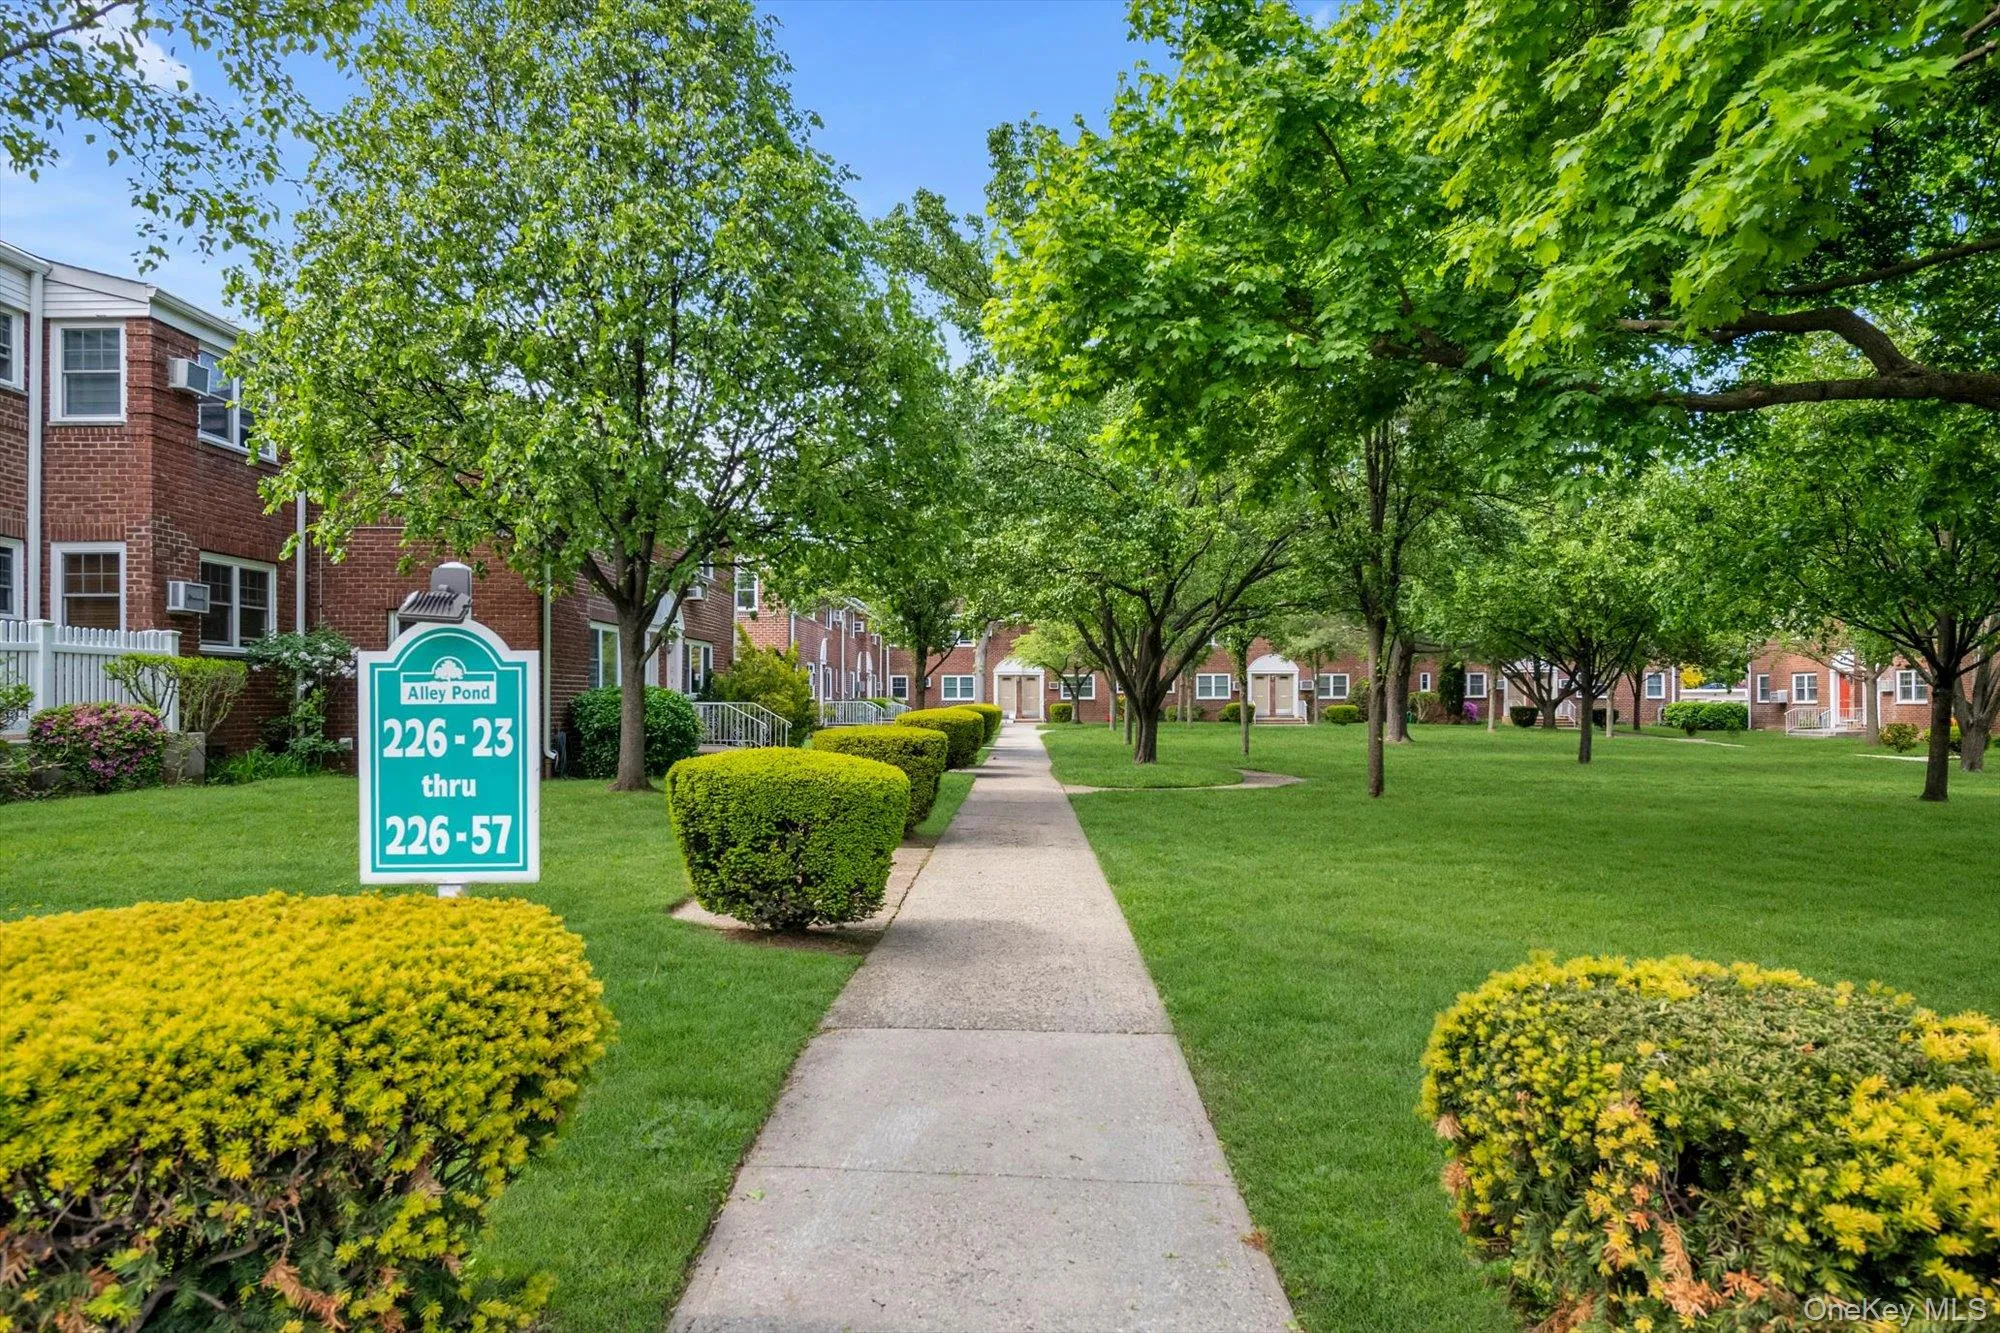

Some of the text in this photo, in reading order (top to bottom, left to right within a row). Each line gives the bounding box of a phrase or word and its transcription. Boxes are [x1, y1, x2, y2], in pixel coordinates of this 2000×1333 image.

[408, 685, 490, 703] Alley Pond
[421, 773, 477, 798] thru
